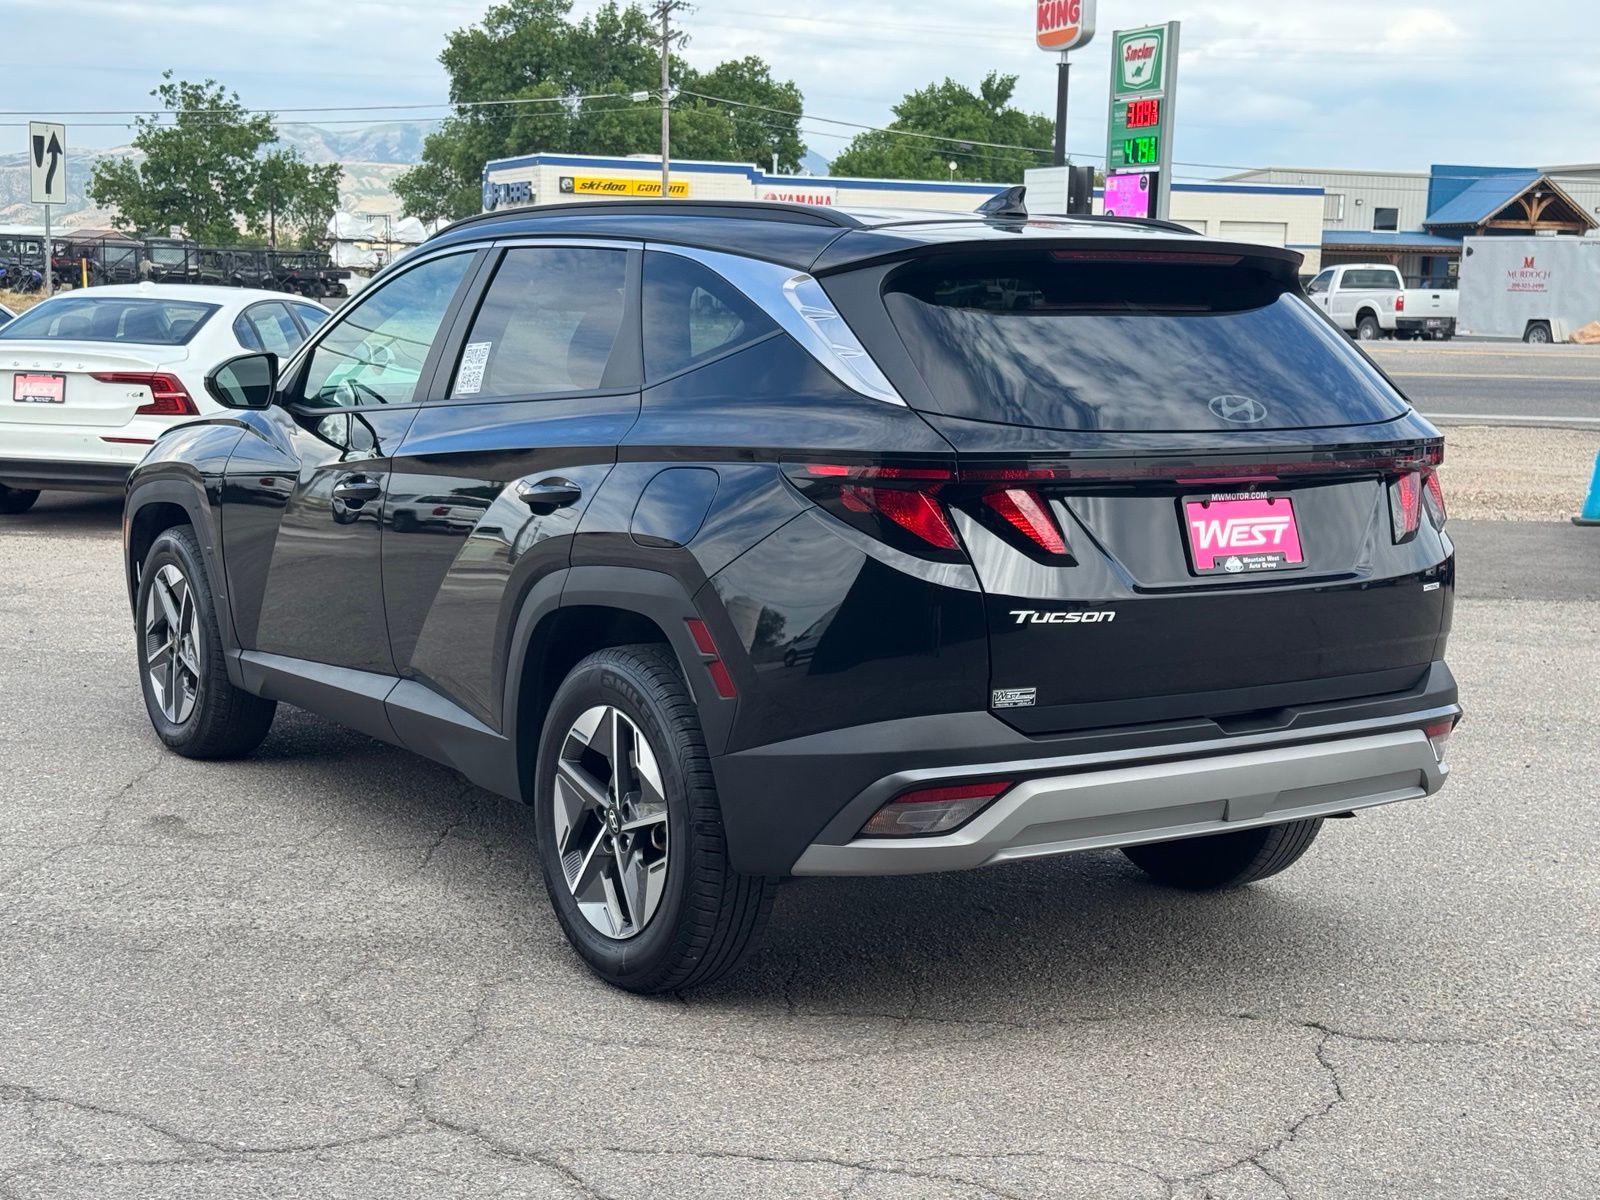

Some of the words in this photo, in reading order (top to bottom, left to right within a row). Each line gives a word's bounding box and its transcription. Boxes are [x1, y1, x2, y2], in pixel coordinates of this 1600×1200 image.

[1038, 0, 1080, 32] KING
[1125, 43, 1155, 62] Sinclair
[579, 180, 627, 192] ski-doo
[637, 183, 685, 194] canam
[779, 193, 832, 206] YAMAHA
[1506, 270, 1551, 280] MURDOCH
[1211, 492, 1268, 501] MWMOTOR.COM
[1192, 516, 1290, 549] WEST
[1261, 561, 1277, 569] Group
